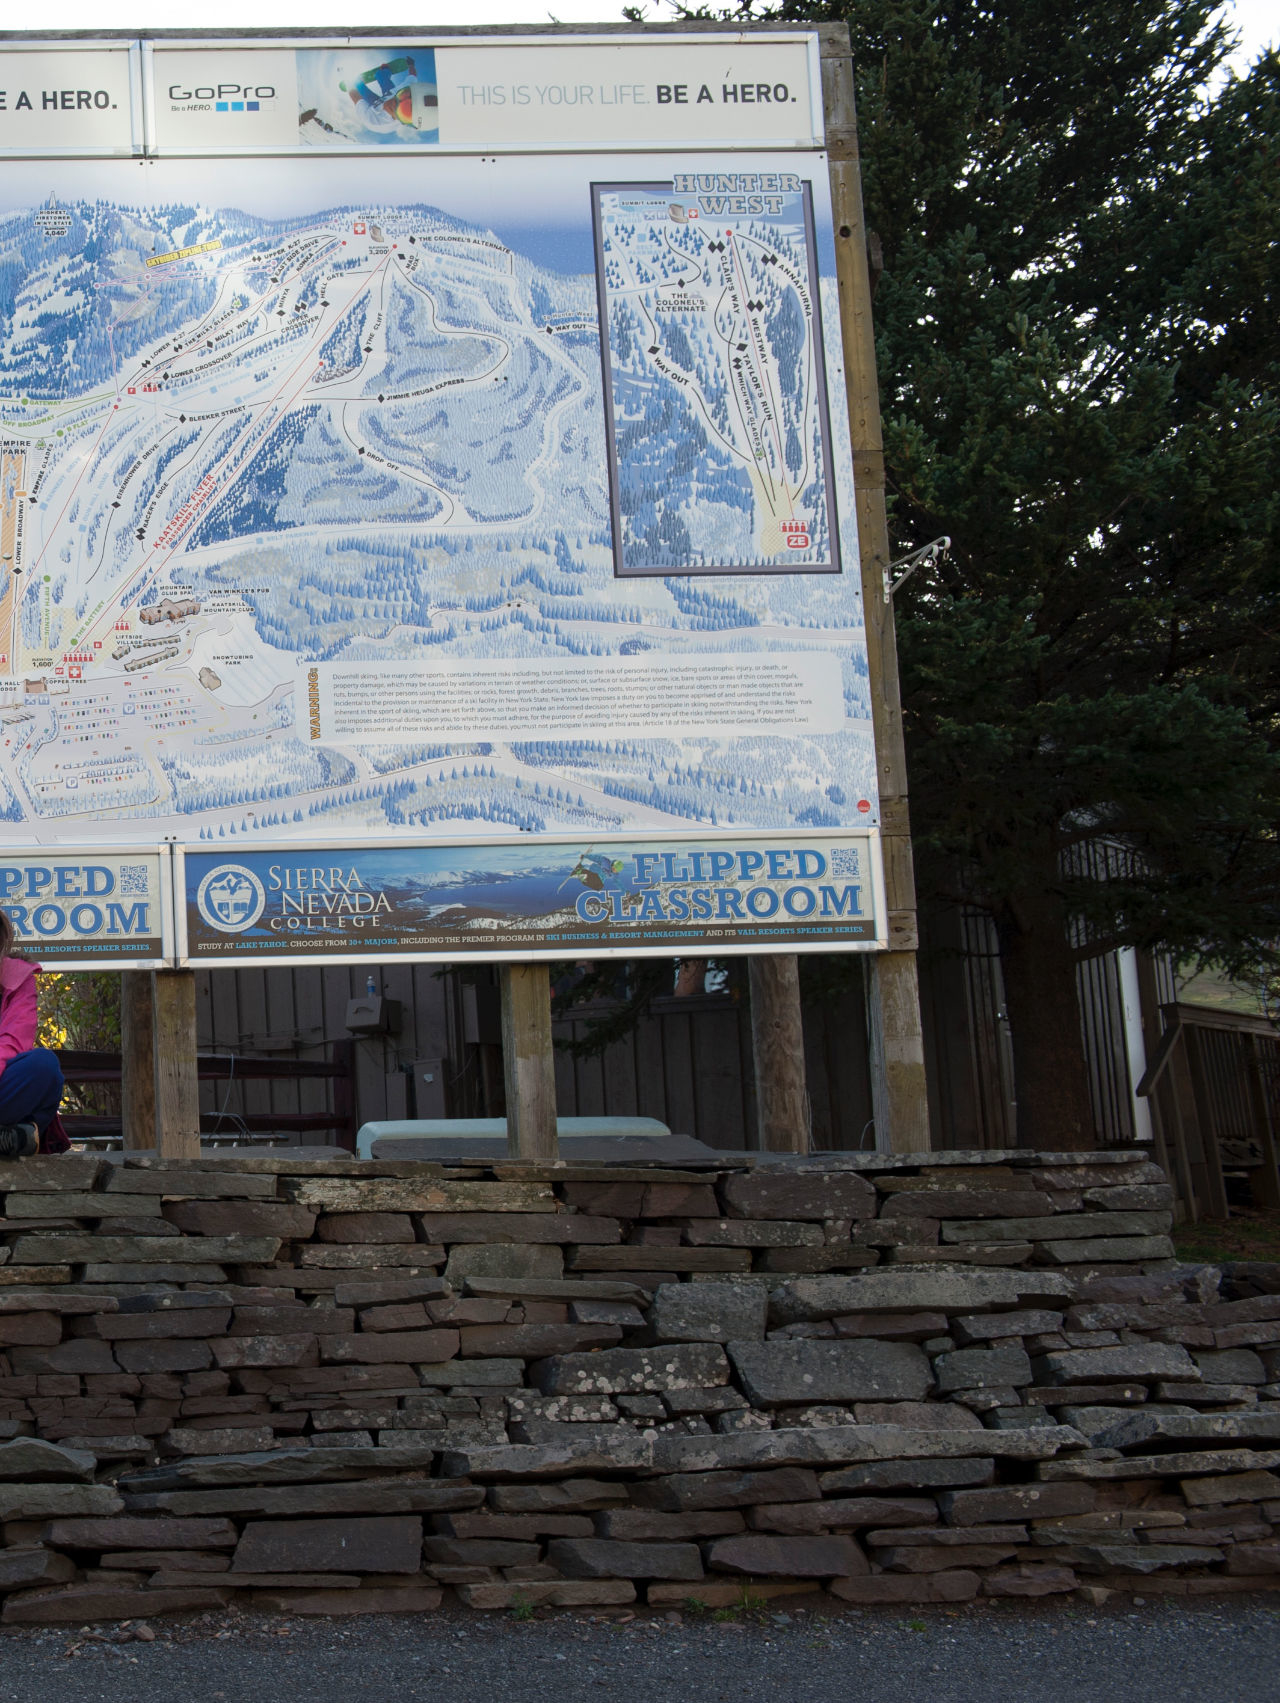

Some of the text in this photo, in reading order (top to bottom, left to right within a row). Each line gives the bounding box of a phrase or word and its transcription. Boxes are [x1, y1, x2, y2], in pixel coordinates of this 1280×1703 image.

[15, 91, 33, 110] A
[42, 90, 117, 110] HERO.
[170, 84, 276, 100] GoPro
[457, 84, 796, 105] THIS IS YOUR LIFE. BE A HERO.
[674, 174, 801, 193] HUNTER
[698, 196, 783, 215] WEST
[473, 239, 511, 254] ALTERNATE
[778, 264, 811, 317] ANNAPURNA
[752, 318, 768, 364] WESTWAY
[171, 352, 233, 378] LOWER CROSSOVER
[189, 406, 246, 422] BLEEKER STREET
[153, 474, 214, 549] KAATSKILL FLYER
[789, 536, 806, 546] ZE
[632, 850, 827, 884] FLIPPED
[269, 865, 364, 895] SIERRA
[282, 891, 394, 915] NEVADA
[576, 885, 863, 923] CLASSROOM
[271, 915, 380, 929] COLLEGE
[365, 938, 400, 946] MAJORS,
[644, 930, 704, 938] MANAGEMENT
